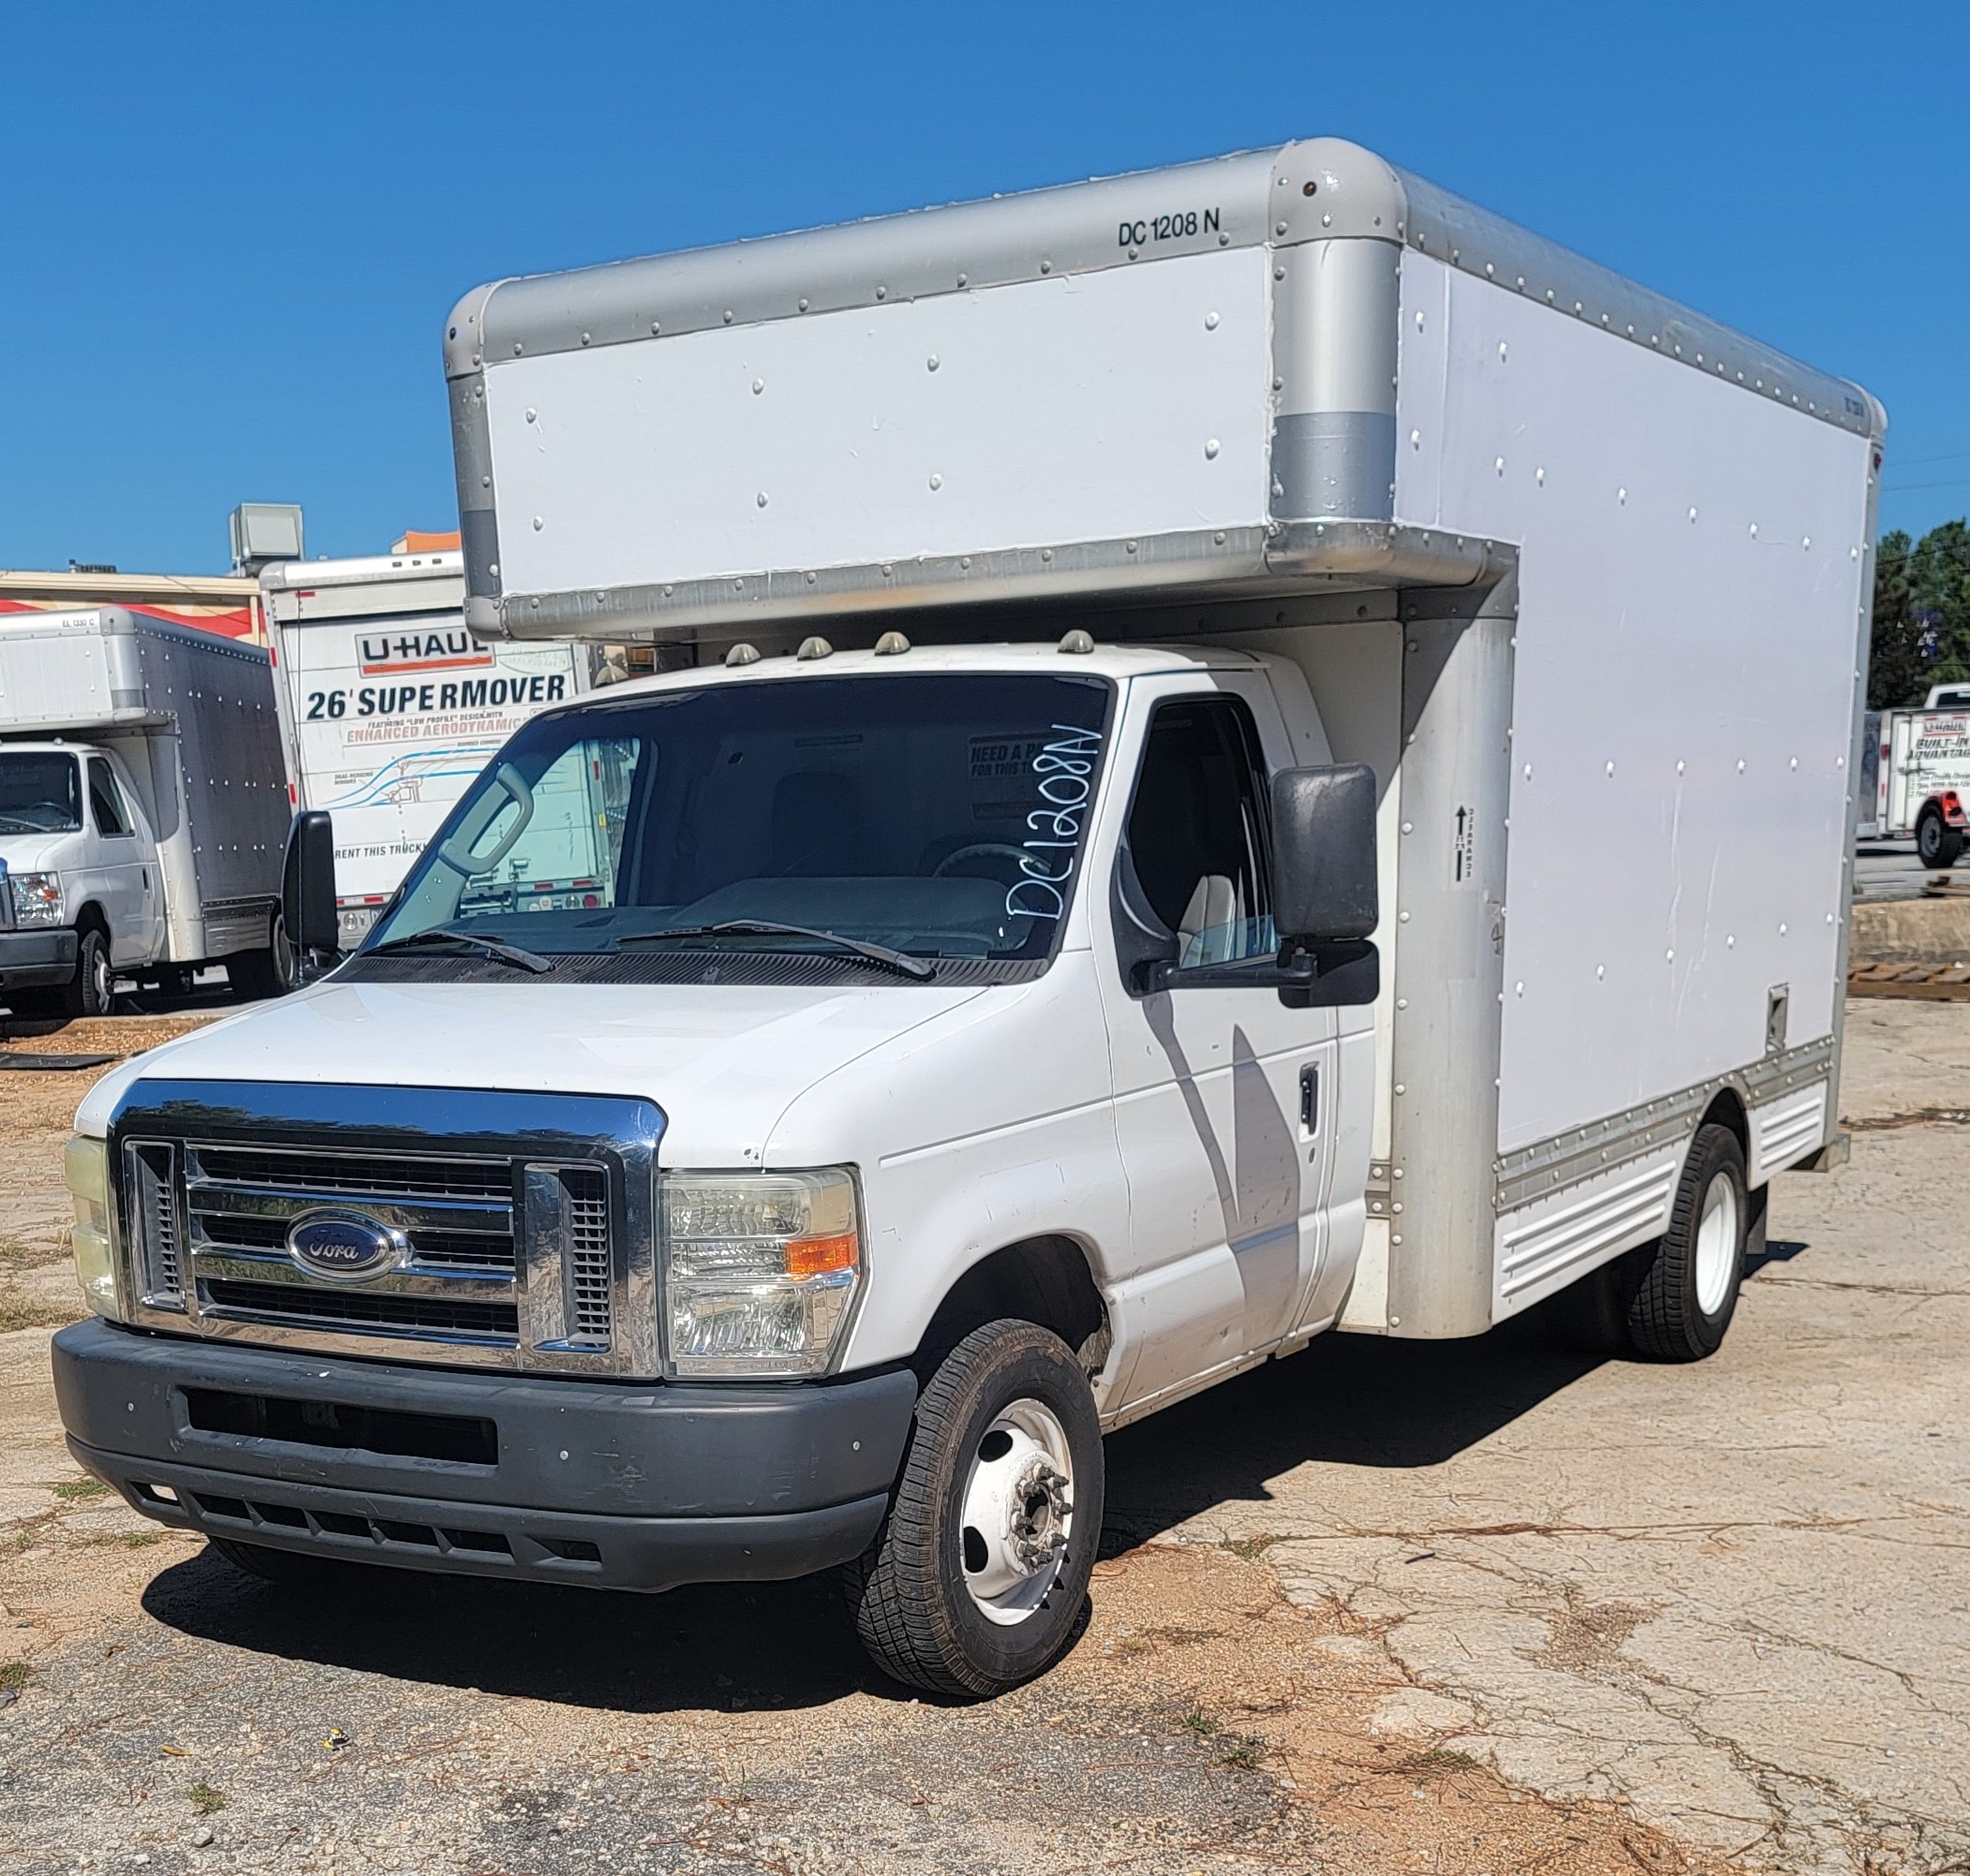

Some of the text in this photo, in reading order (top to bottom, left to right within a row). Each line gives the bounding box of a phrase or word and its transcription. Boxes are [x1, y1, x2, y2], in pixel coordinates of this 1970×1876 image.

[1118, 207, 1220, 246] DC 1208 N
[363, 632, 489, 661] U-HAUL
[347, 726, 419, 743] ENHANCED
[970, 746, 1008, 764] NEED
[1011, 744, 1021, 761] A
[971, 764, 992, 777] FOR
[995, 762, 1019, 776] THIS
[1005, 723, 1103, 921] DC1208N
[334, 848, 361, 860] RENT
[363, 846, 386, 858] THIS
[390, 843, 422, 856] TRUCK
[309, 1228, 359, 1260] Ford
